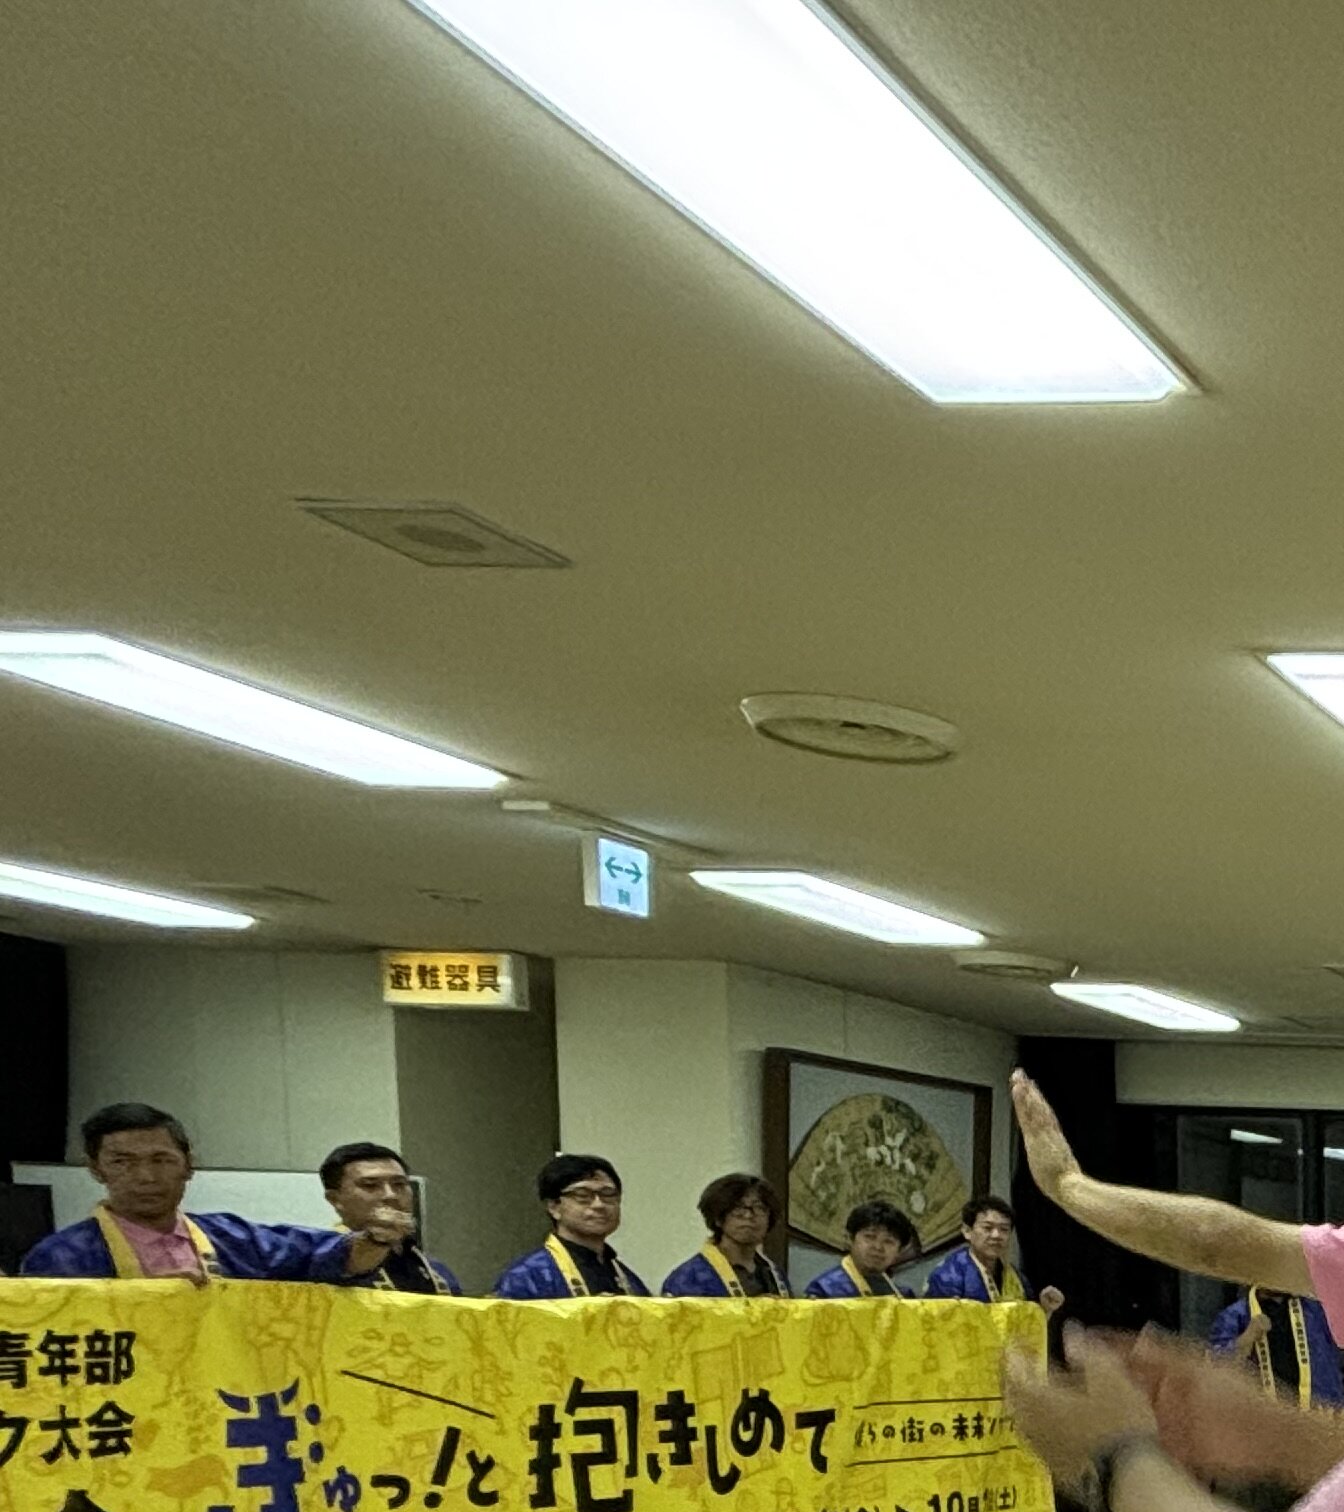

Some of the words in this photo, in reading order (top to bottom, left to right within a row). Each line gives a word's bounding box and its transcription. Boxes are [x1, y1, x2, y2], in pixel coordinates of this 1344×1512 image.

[389, 963, 501, 993] 避難器具
[0, 1329, 136, 1389] 青年部
